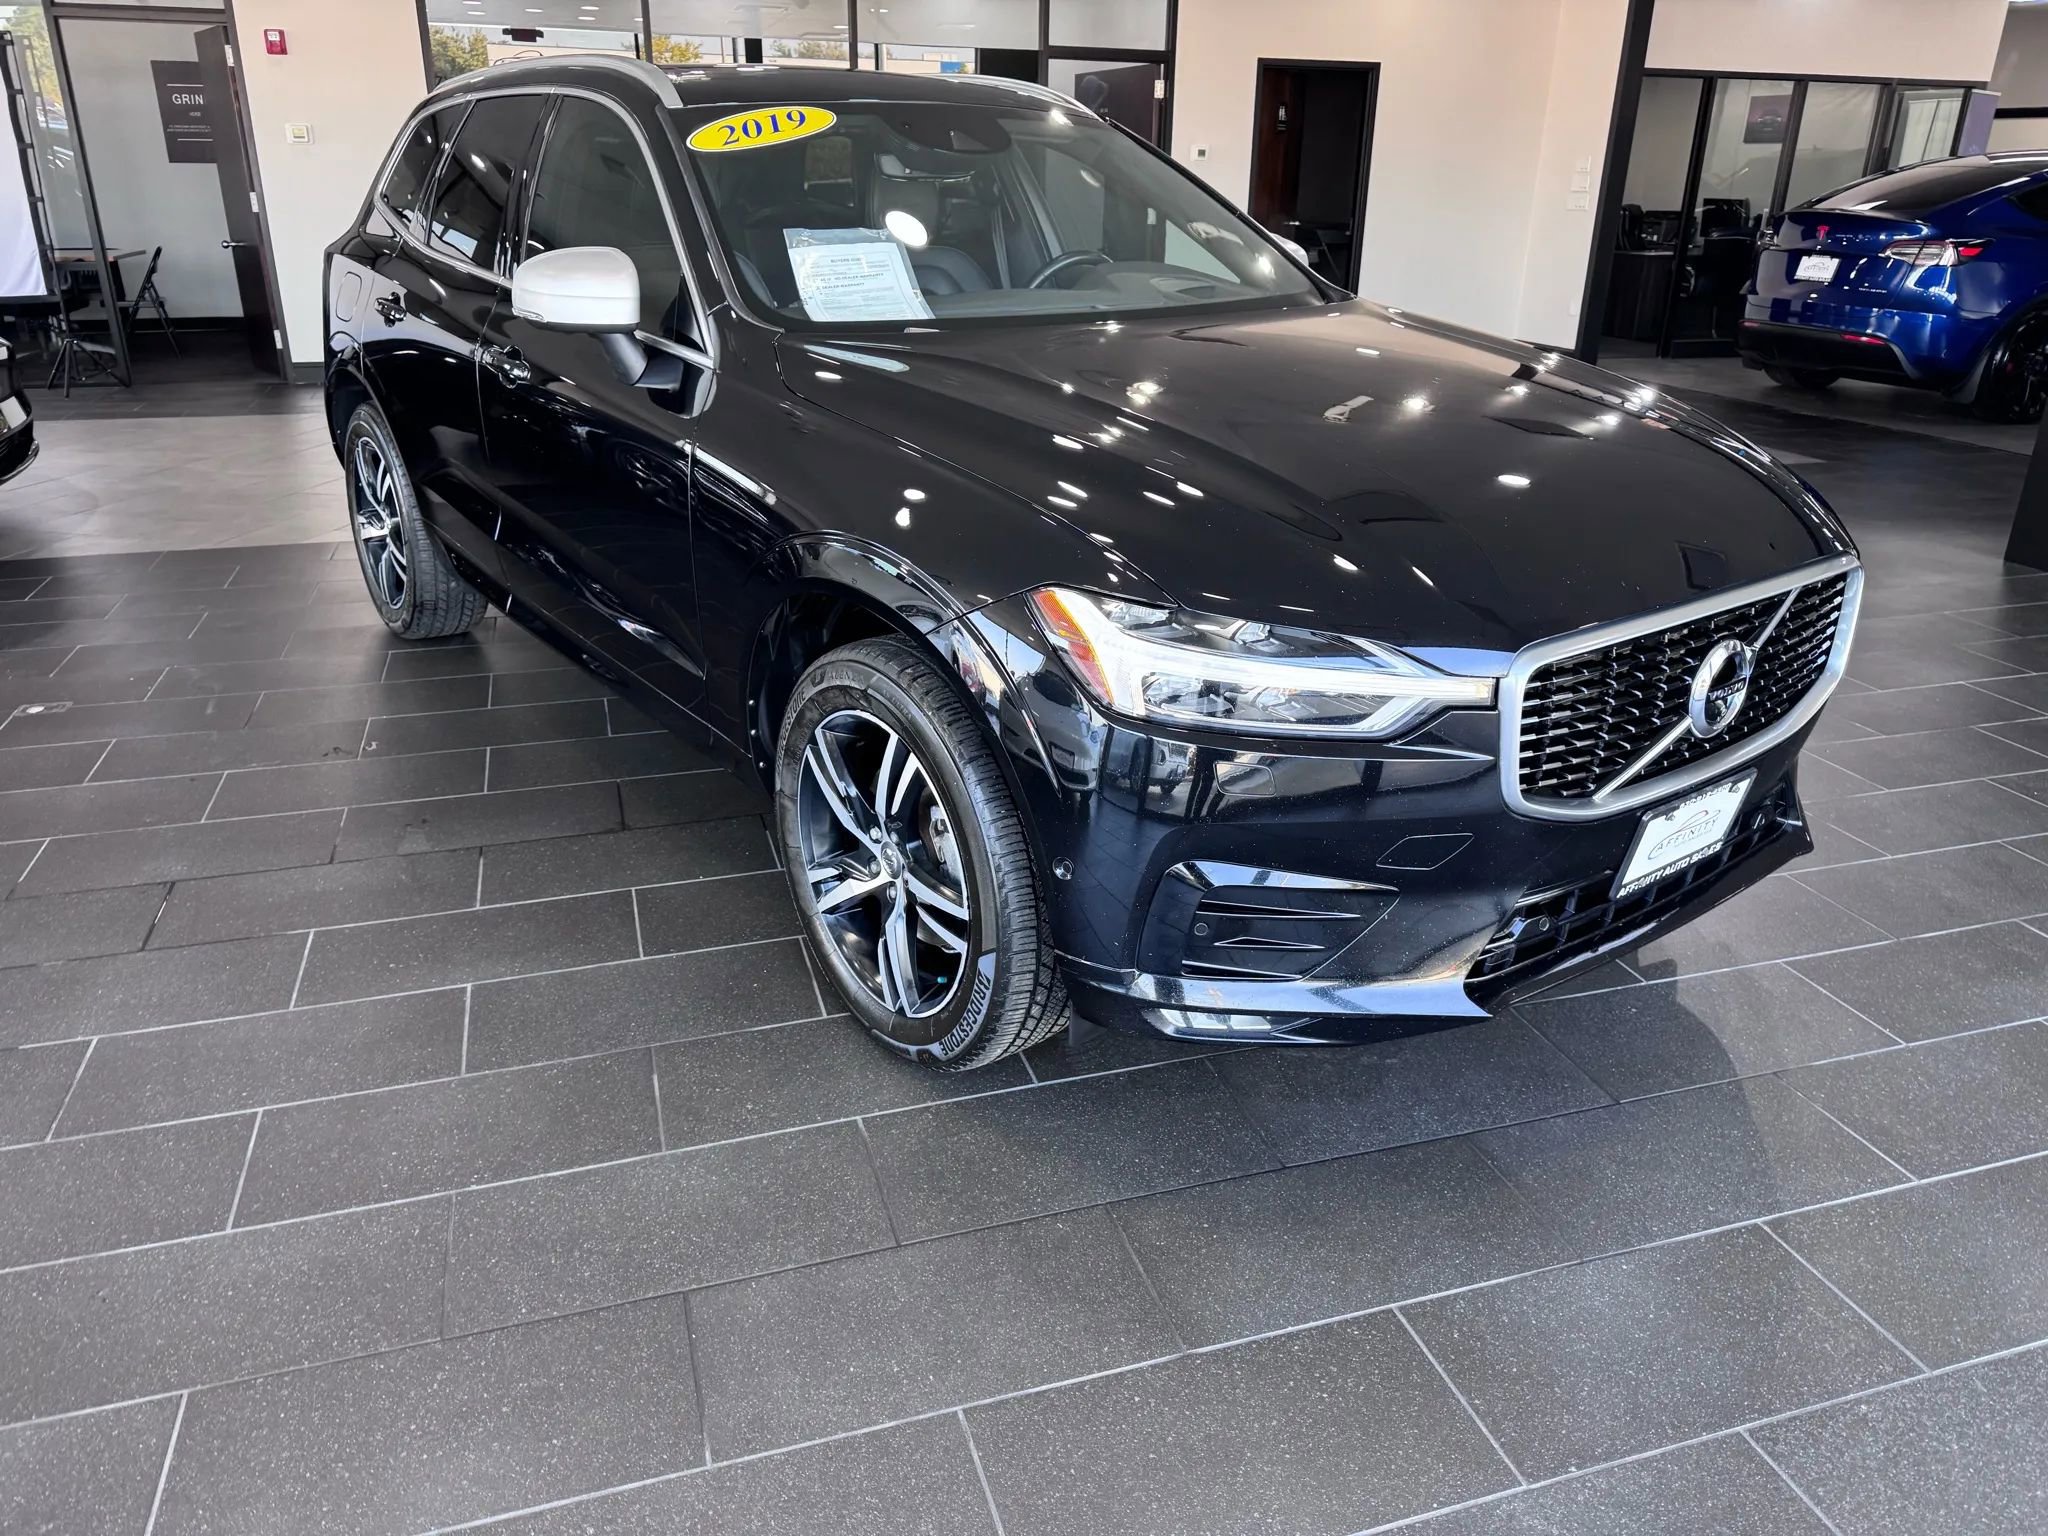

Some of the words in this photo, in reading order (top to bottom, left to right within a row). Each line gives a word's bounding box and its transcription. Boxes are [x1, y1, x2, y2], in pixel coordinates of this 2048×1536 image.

[717, 109, 806, 146] 2019
[1708, 681, 1745, 701] VOLVO
[1654, 817, 1719, 852] AFFINITY
[1662, 857, 1690, 877] AUTO
[938, 968, 992, 1056] BRIDGESTONE
